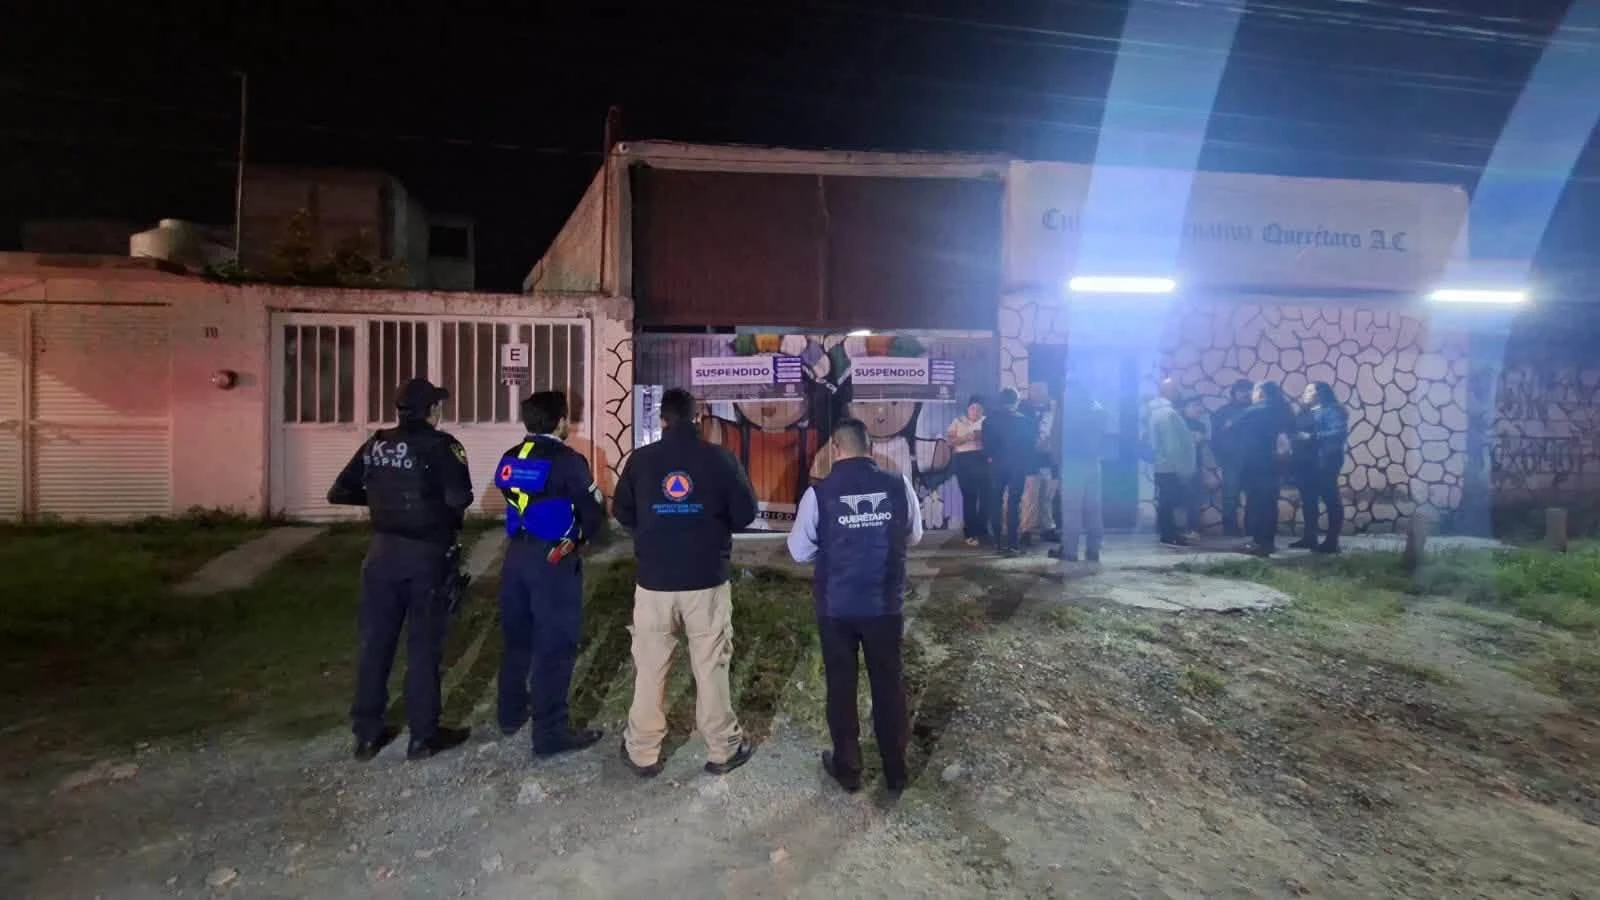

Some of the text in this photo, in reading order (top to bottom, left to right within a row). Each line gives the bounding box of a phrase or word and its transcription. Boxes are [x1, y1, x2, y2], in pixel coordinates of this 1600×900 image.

[510, 348, 521, 361] E
[695, 367, 770, 377] SUSPENDIDO
[854, 367, 926, 377] SUSPENDIDO
[371, 440, 408, 458] K-9
[838, 512, 892, 526] QUERÉTARO
